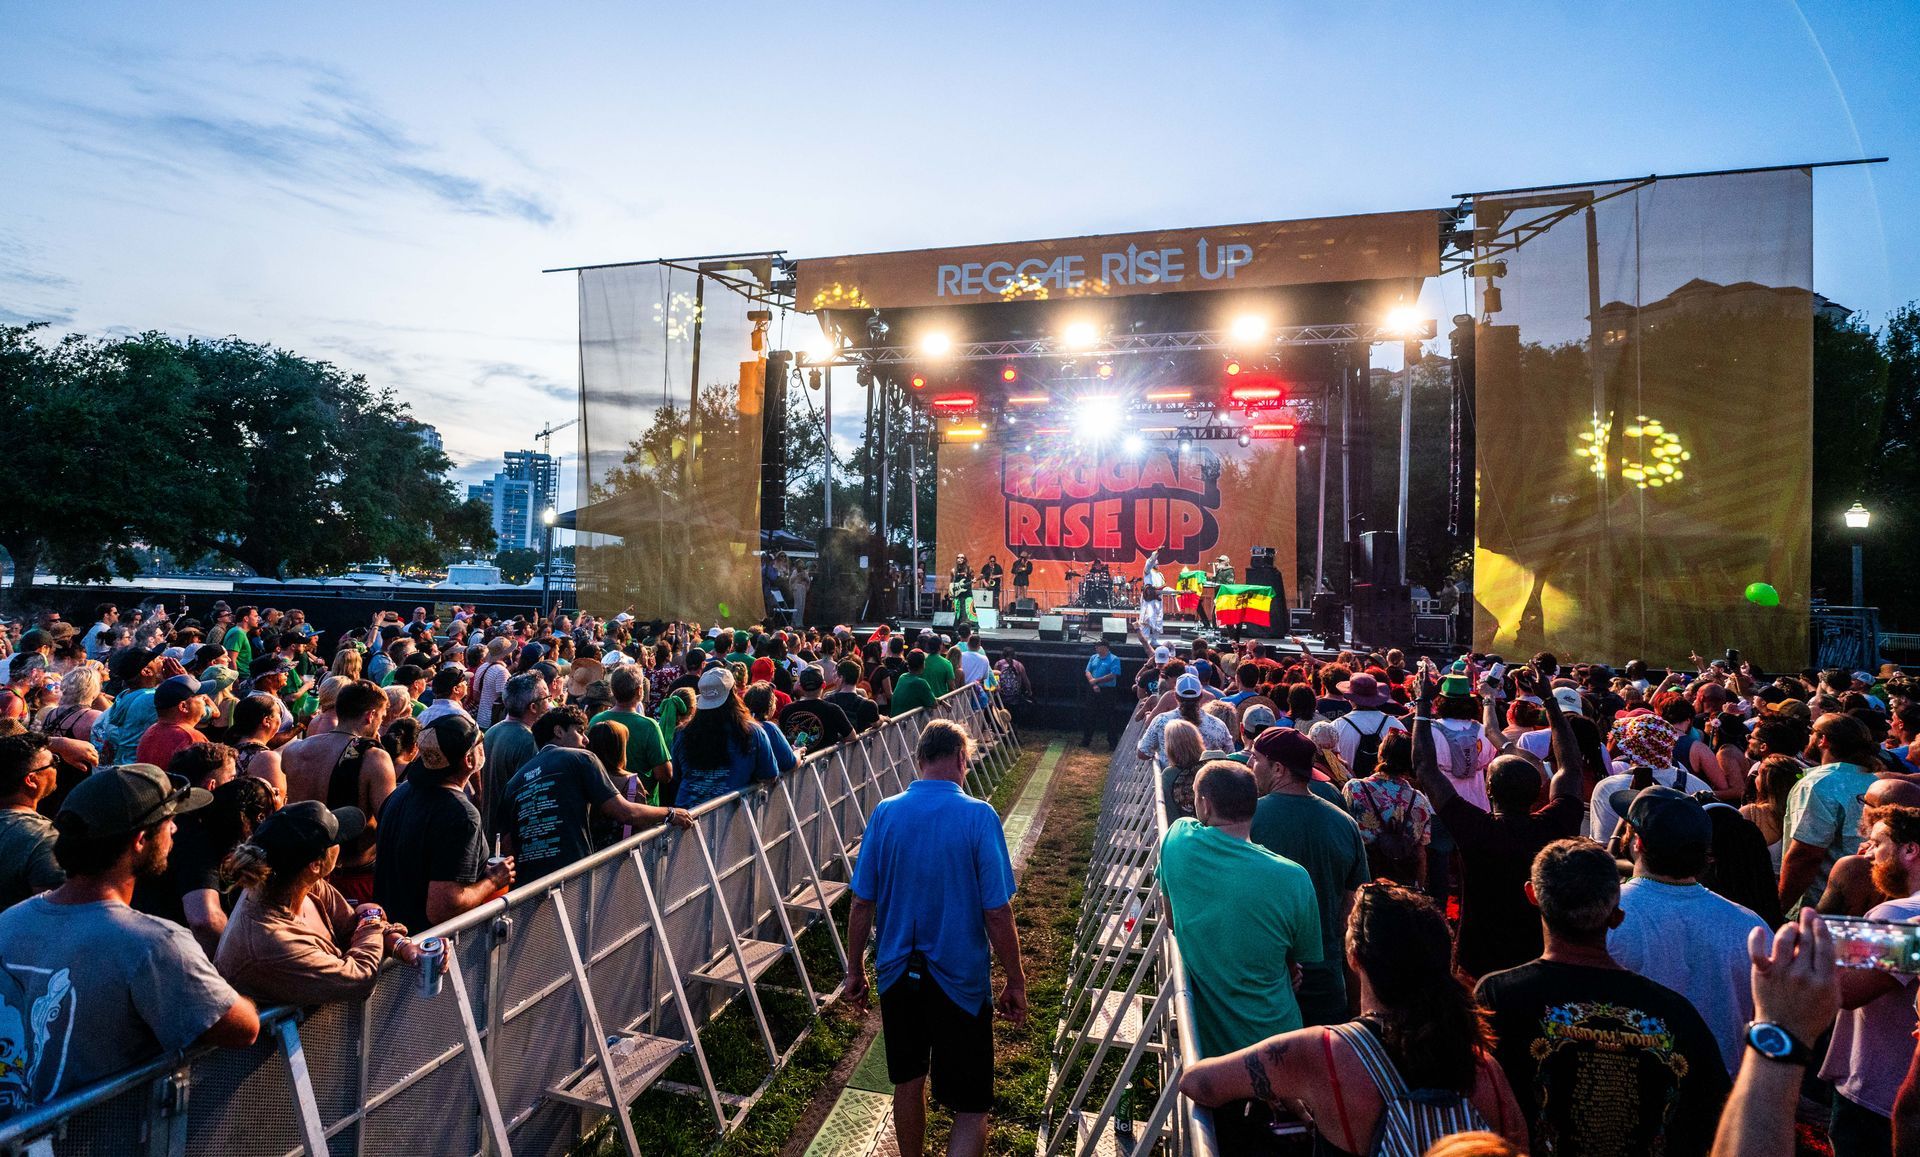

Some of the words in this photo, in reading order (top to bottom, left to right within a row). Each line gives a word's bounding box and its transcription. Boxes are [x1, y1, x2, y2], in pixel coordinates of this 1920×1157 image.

[937, 255, 1086, 297] REGGAE
[1101, 242, 1185, 287] RISE
[1197, 236, 1253, 280] UP
[1004, 447, 1207, 500] REGGAE
[1008, 499, 1123, 549] RISE
[1134, 497, 1204, 551] UP
[1562, 1025, 1615, 1042] WISDOM
[1620, 1031, 1660, 1049] TOUR
